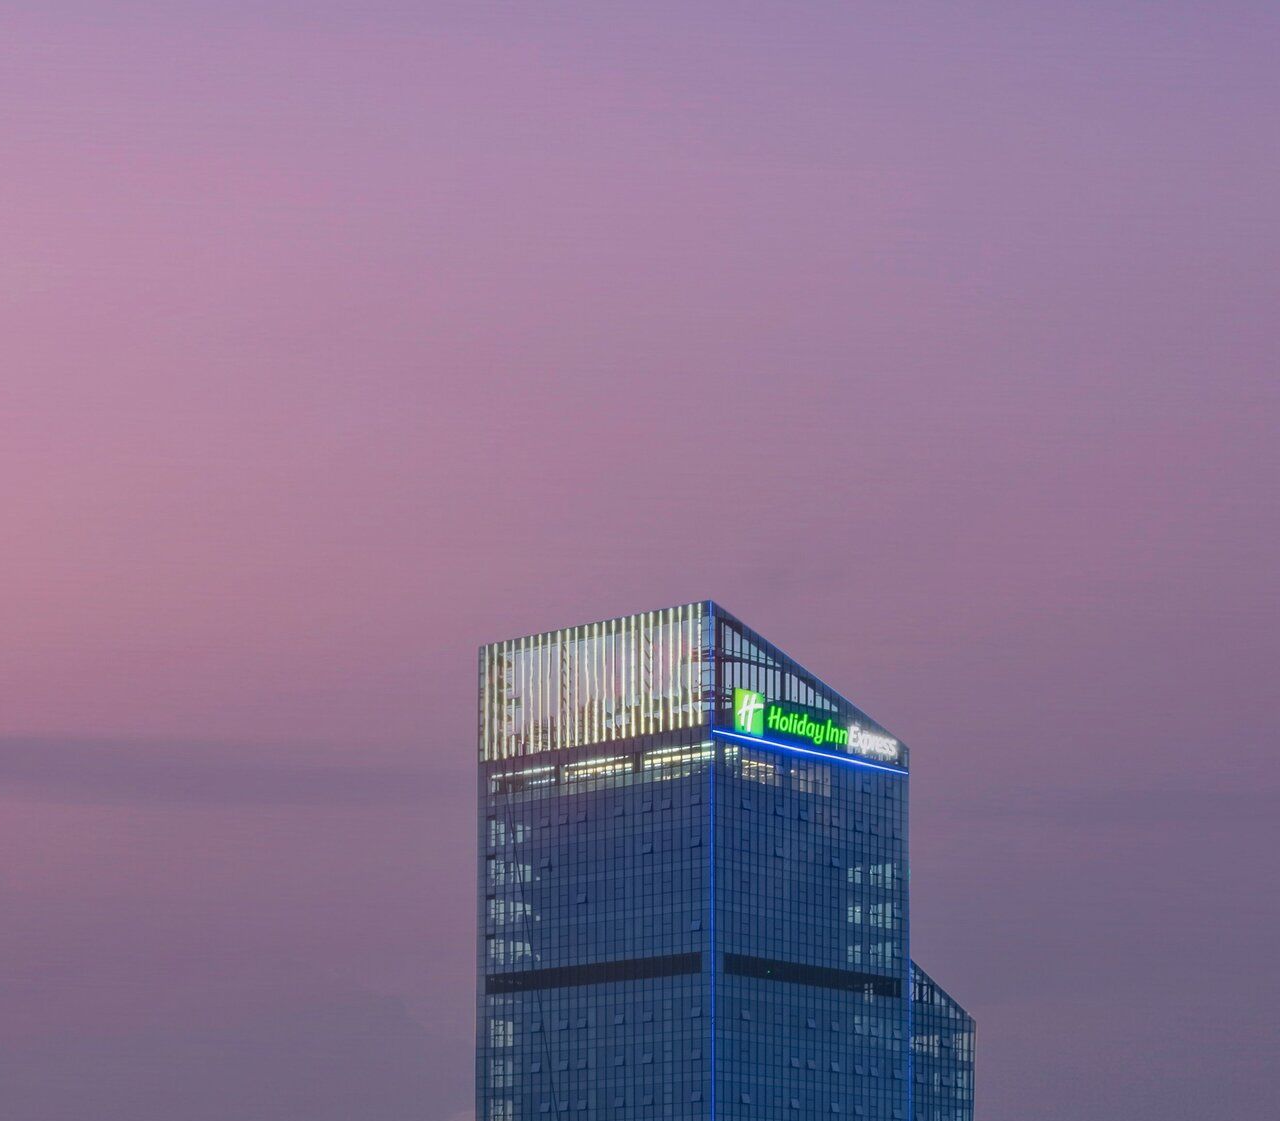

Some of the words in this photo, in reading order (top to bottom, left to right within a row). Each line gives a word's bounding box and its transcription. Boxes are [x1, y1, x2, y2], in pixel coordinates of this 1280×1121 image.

[768, 706, 825, 744] Holiday
[826, 719, 848, 745] Inn
[849, 725, 897, 756] Express
